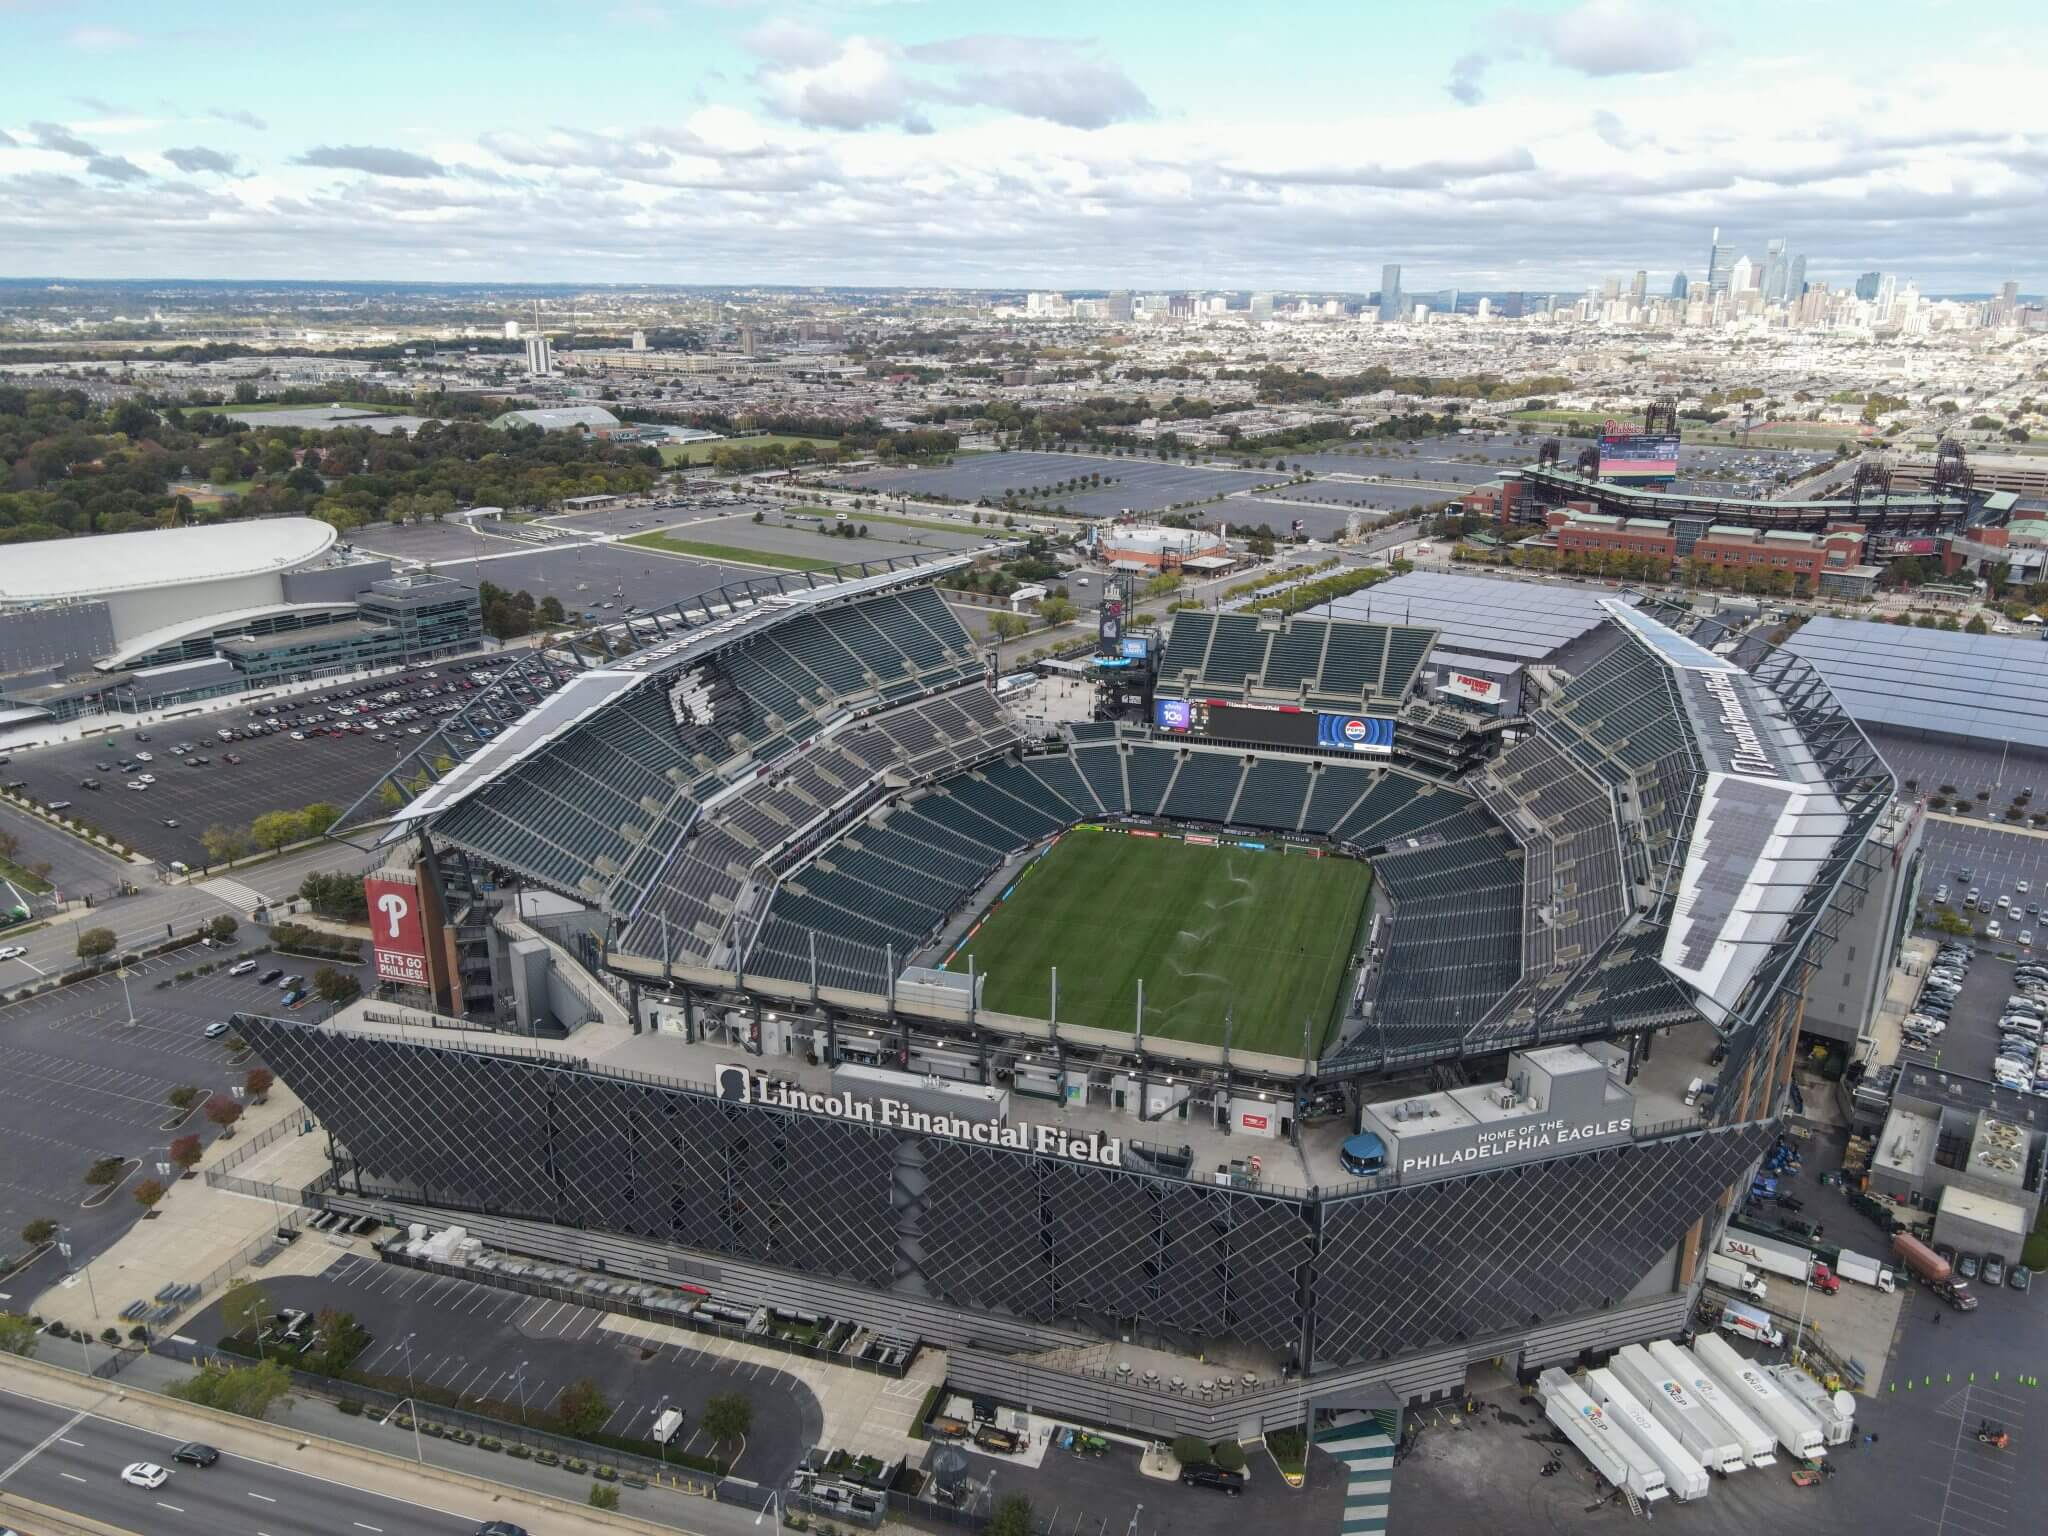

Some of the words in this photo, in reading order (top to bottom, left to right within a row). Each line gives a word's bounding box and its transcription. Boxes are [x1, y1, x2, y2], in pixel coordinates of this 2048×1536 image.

[378, 894, 408, 938] P
[379, 952, 404, 967] LET'S
[407, 957, 422, 969] GO
[380, 964, 424, 980] PHILLIES!
[758, 1076, 874, 1122] Lincoln
[880, 1098, 1029, 1150] Financial
[1035, 1124, 1121, 1166] Field
[1478, 1130, 1515, 1143] HOME
[1519, 1125, 1535, 1136] OF
[1539, 1120, 1564, 1132] THE
[1402, 1136, 1550, 1172] PHILADELPHIA
[1557, 1118, 1632, 1143] EAGLES
[1727, 1241, 1759, 1260] SAIA
[1670, 1390, 1688, 1406] NEP
[1588, 1413, 1609, 1431] NEP
